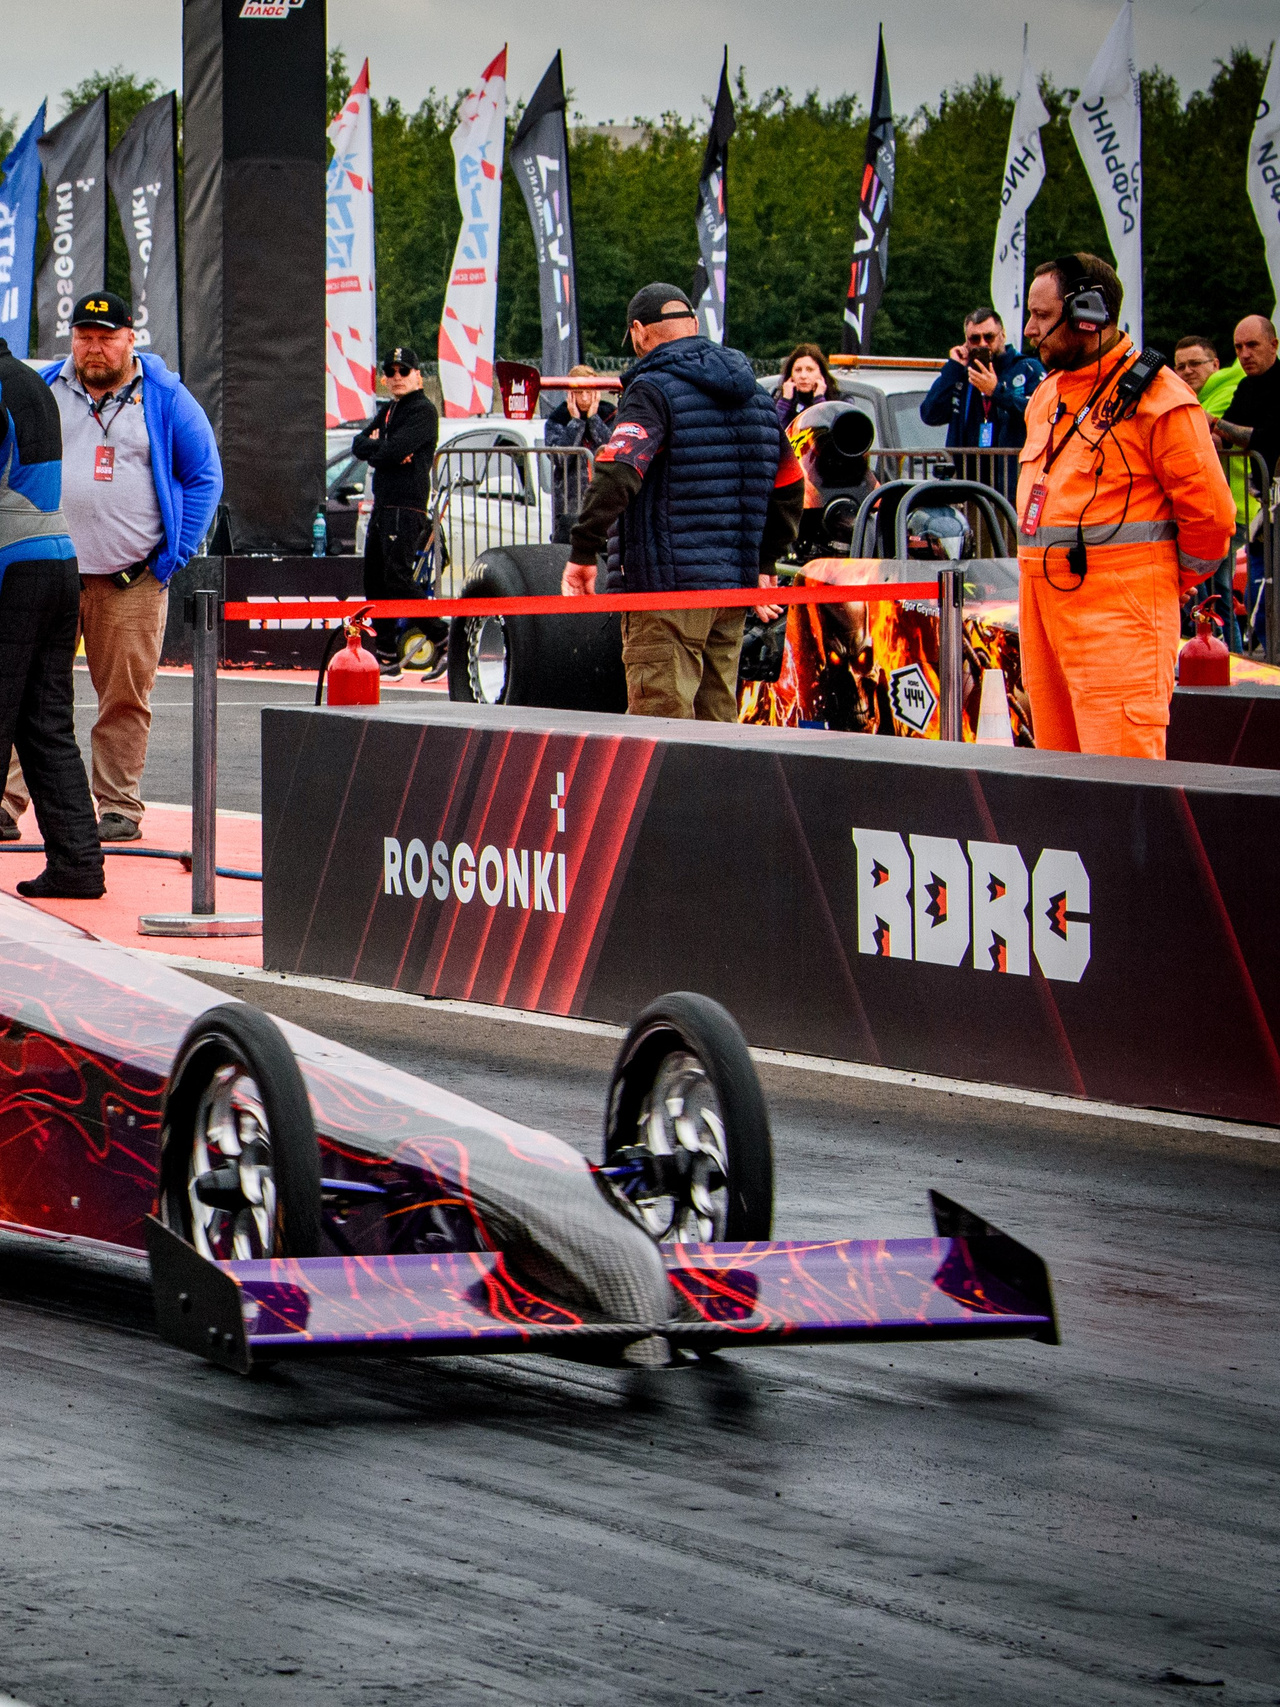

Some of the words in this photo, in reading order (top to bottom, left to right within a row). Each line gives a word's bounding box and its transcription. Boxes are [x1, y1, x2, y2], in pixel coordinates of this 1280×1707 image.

[244, 6, 284, 16] ПЛЮС
[85, 300, 109, 313] 4,3
[904, 687, 925, 709] 444
[383, 836, 567, 914] ROSGONKI
[851, 826, 1091, 983] RDRC
